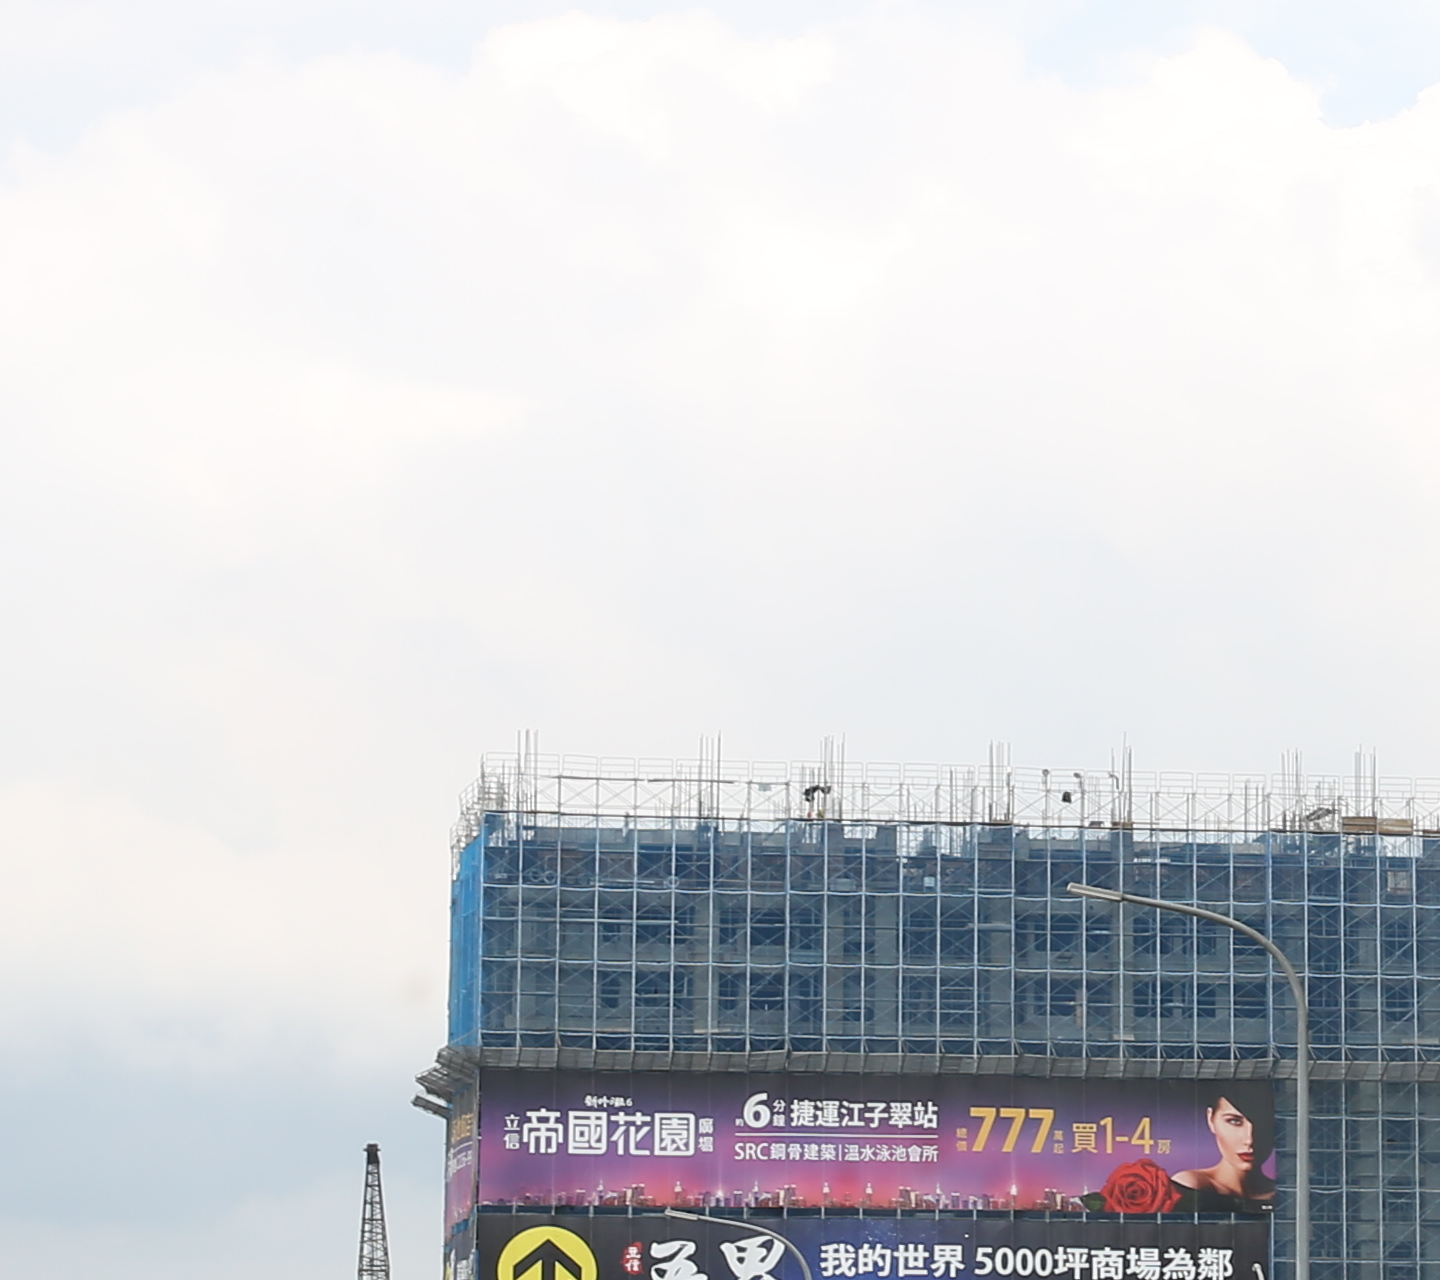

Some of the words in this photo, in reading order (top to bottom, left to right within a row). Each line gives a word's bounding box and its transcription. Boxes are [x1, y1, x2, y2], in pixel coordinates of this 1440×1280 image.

[743, 1092, 772, 1129] 6
[789, 1099, 940, 1129] 捷運江子翠站
[969, 1106, 1055, 1154] 777
[522, 1107, 696, 1157] 帝國花園
[818, 1243, 966, 1280] 我的世界
